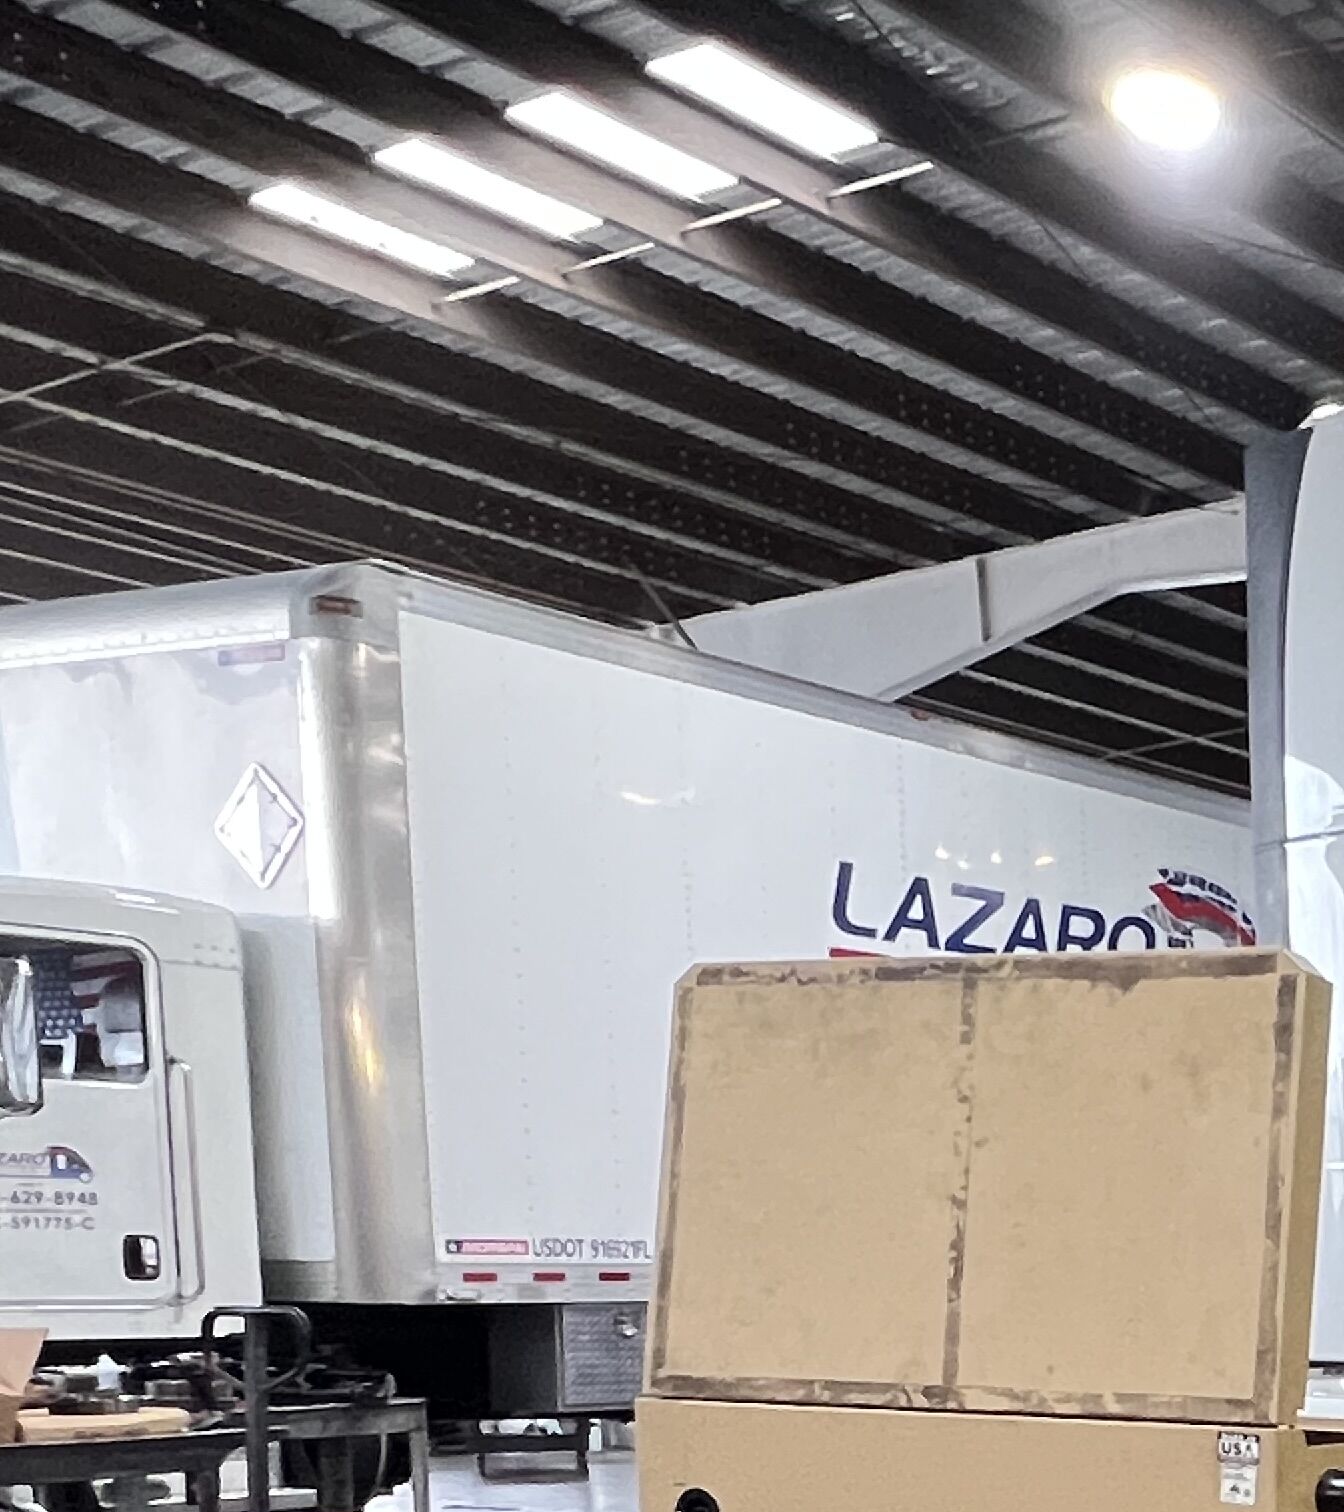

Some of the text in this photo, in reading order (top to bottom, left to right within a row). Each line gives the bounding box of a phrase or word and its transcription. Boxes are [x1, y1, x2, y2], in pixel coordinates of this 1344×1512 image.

[828, 860, 1157, 955] LAZARO
[0, 1216, 96, 1230] -591775-C
[532, 1238, 585, 1258] USDOT
[1221, 1442, 1255, 1458] USA
